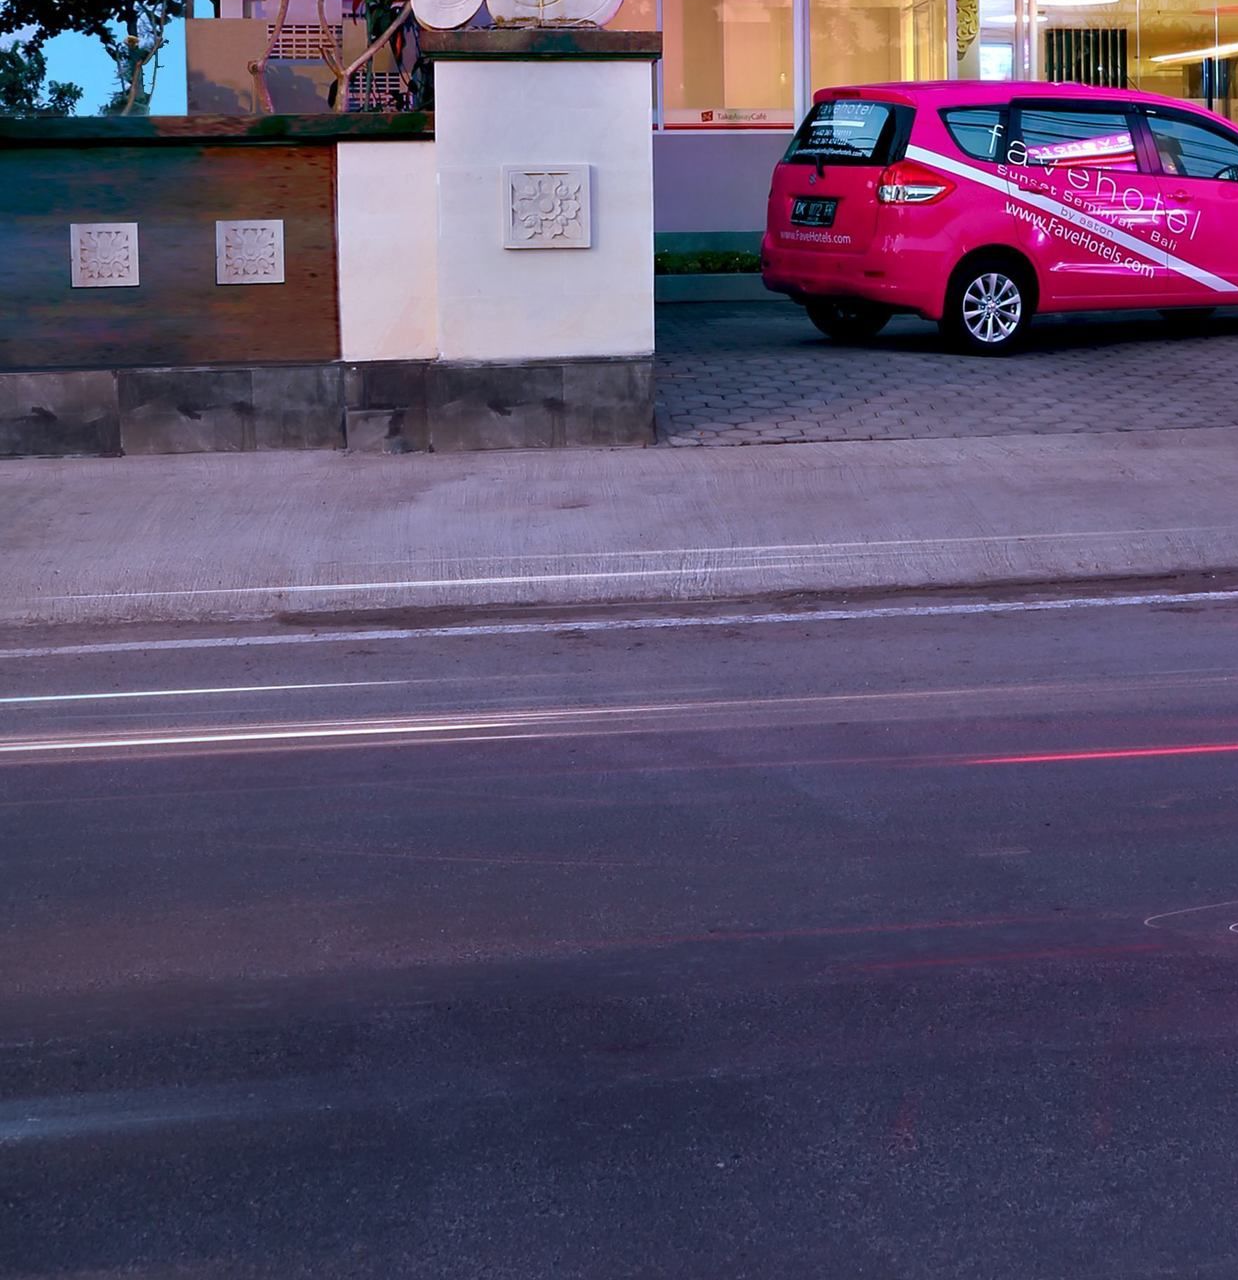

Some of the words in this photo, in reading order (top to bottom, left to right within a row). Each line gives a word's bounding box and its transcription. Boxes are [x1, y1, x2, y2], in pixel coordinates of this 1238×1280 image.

[988, 124, 1201, 240] favehotel
[996, 163, 1058, 196] Sunset
[1062, 189, 1137, 231] Seminyak
[1150, 230, 1178, 252] Bali
[780, 229, 852, 245] www.FaveHotels.com
[1004, 201, 1156, 279] www.FaveHotels.com
[1060, 206, 1075, 221] by
[1080, 215, 1115, 238] aston
